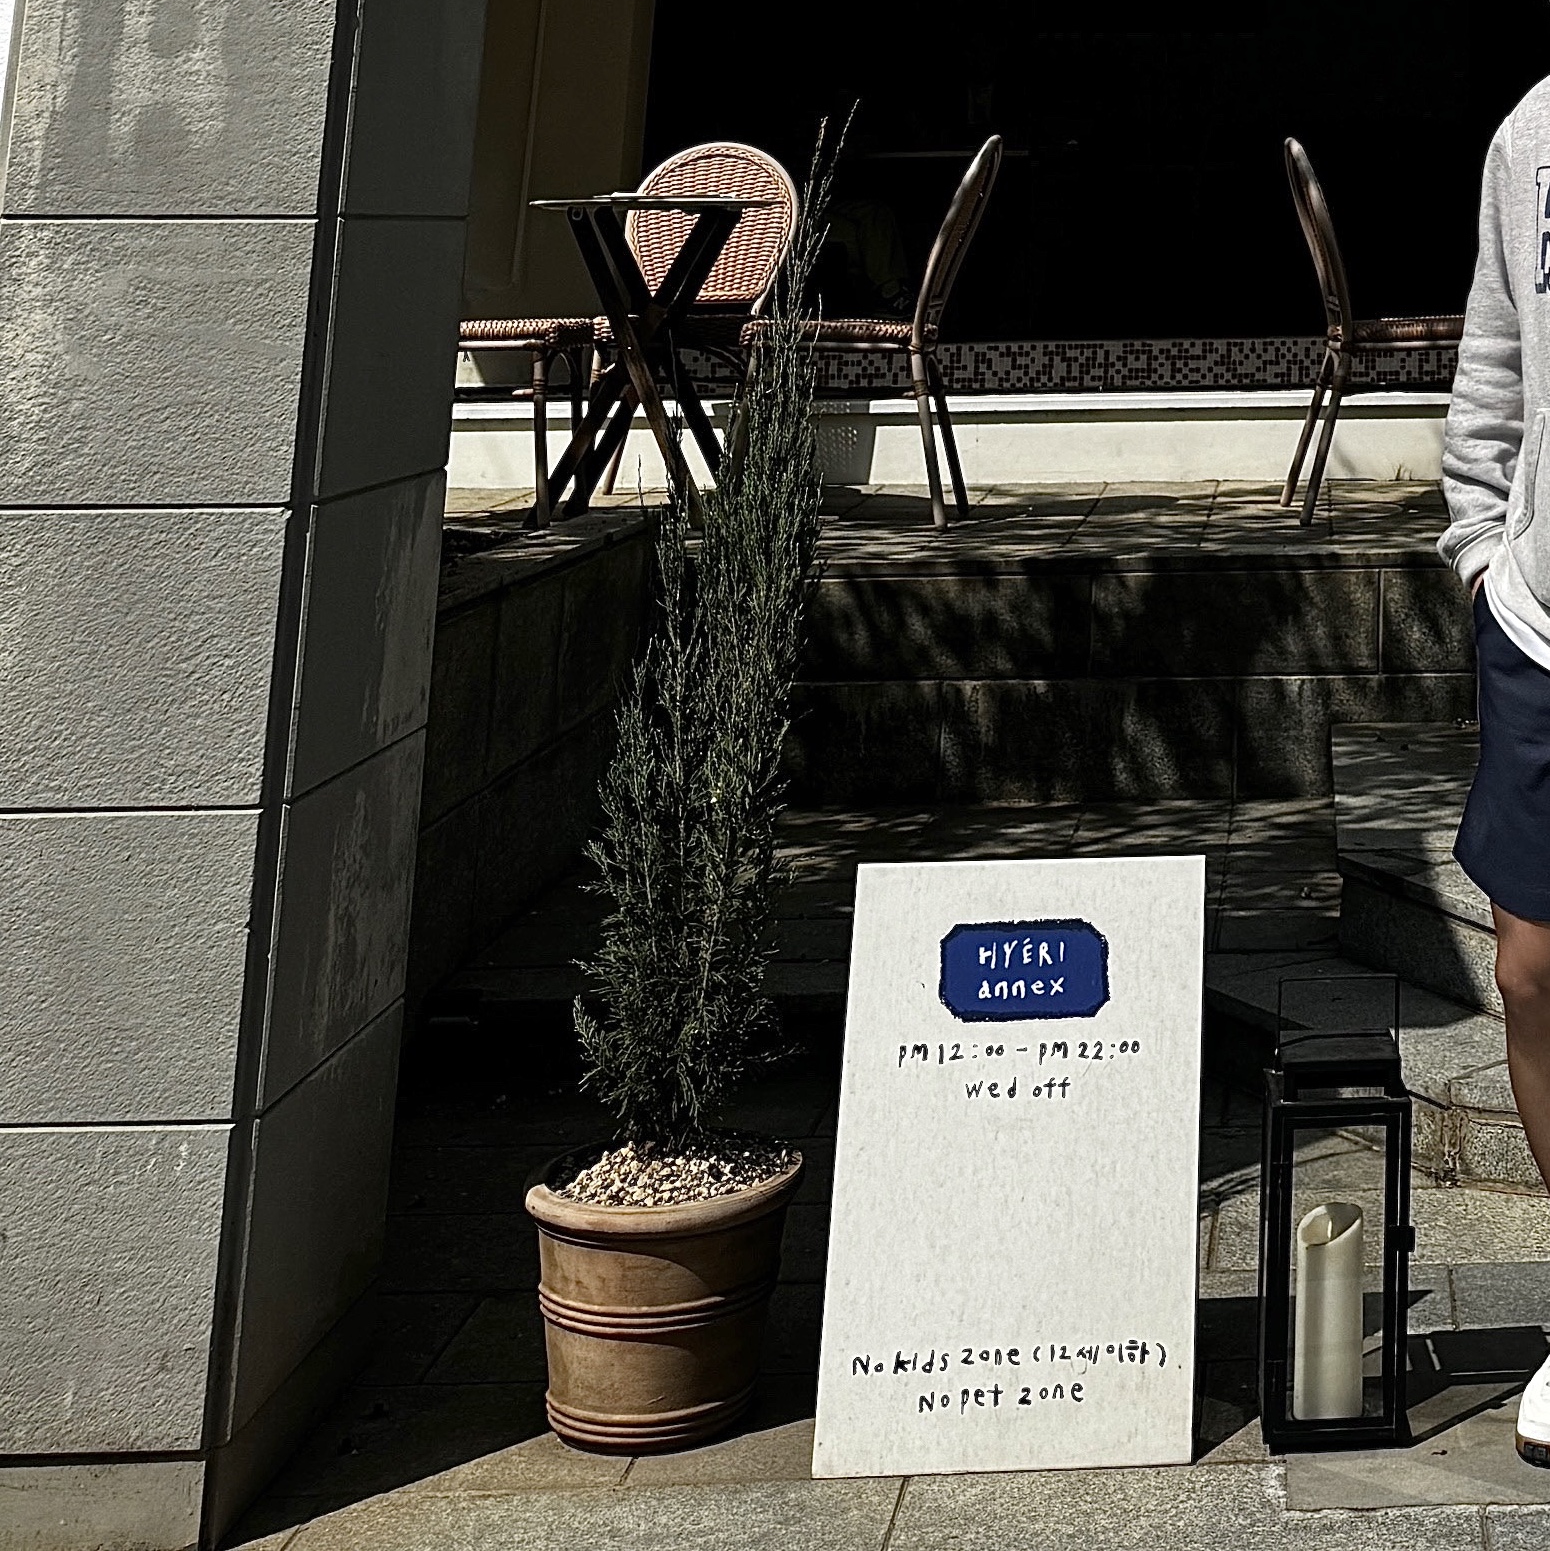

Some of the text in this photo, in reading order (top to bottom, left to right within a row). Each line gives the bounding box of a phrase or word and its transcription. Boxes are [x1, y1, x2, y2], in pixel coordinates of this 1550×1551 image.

[978, 977, 1064, 1000] annex
[938, 1043, 1005, 1065] 12:00
[1078, 1040, 1140, 1061] 22:00
[1032, 1076, 1071, 1099] off
[852, 1354, 884, 1376] No
[892, 1349, 950, 1375] kids
[960, 1347, 1021, 1366] zone
[918, 1382, 1084, 1415] No pet zone
